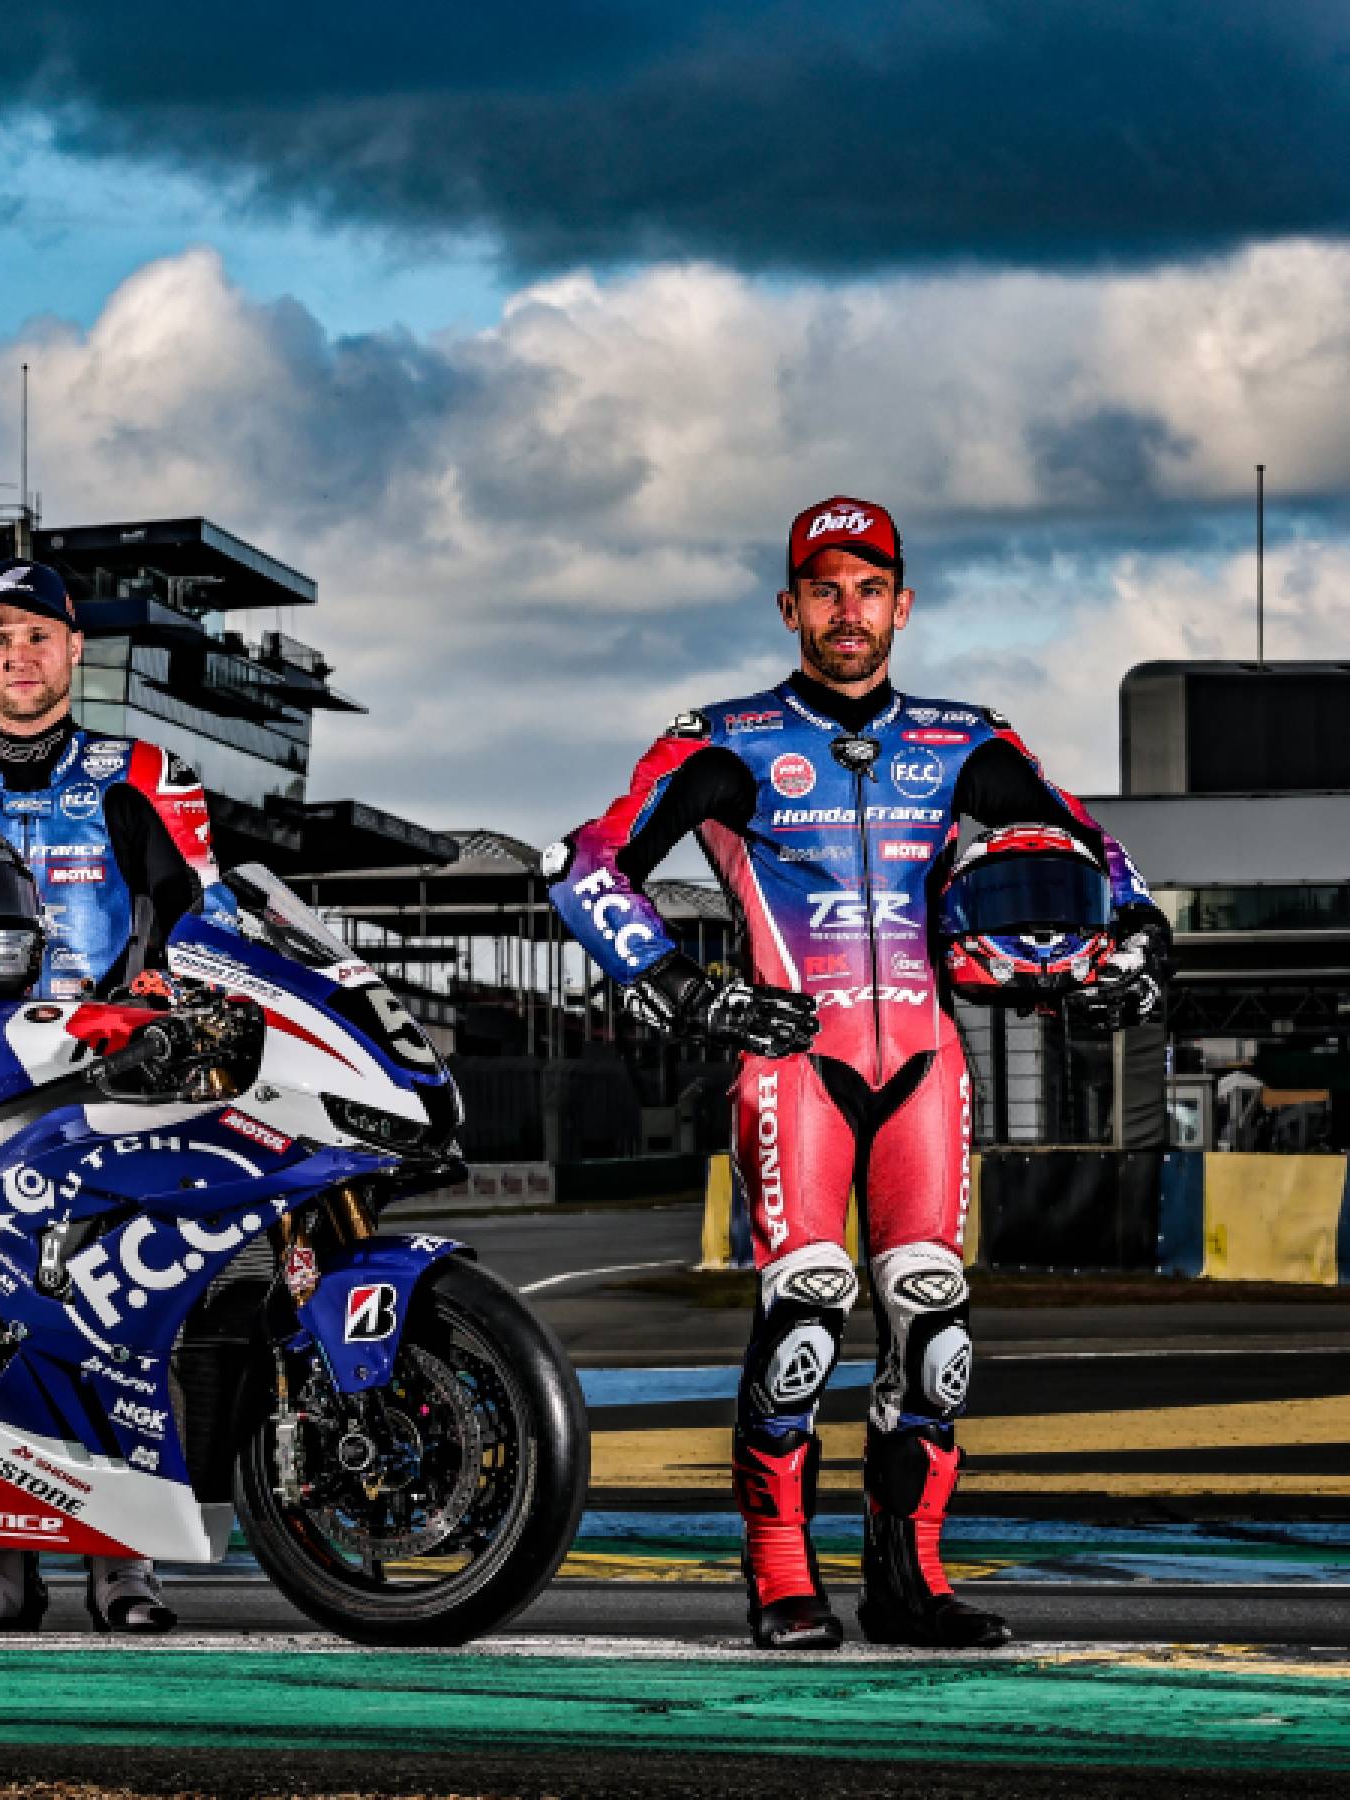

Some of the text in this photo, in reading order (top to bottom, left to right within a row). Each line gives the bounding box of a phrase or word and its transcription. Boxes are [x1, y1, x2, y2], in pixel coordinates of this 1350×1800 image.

[806, 510, 874, 540] Dafy
[771, 803, 944, 825] Honda France
[52, 866, 104, 882] MOTUL
[806, 890, 922, 928] TSR
[226, 1110, 287, 1150] MOTUL
[758, 1071, 790, 1250] HONDA
[113, 1397, 168, 1432] NGK
